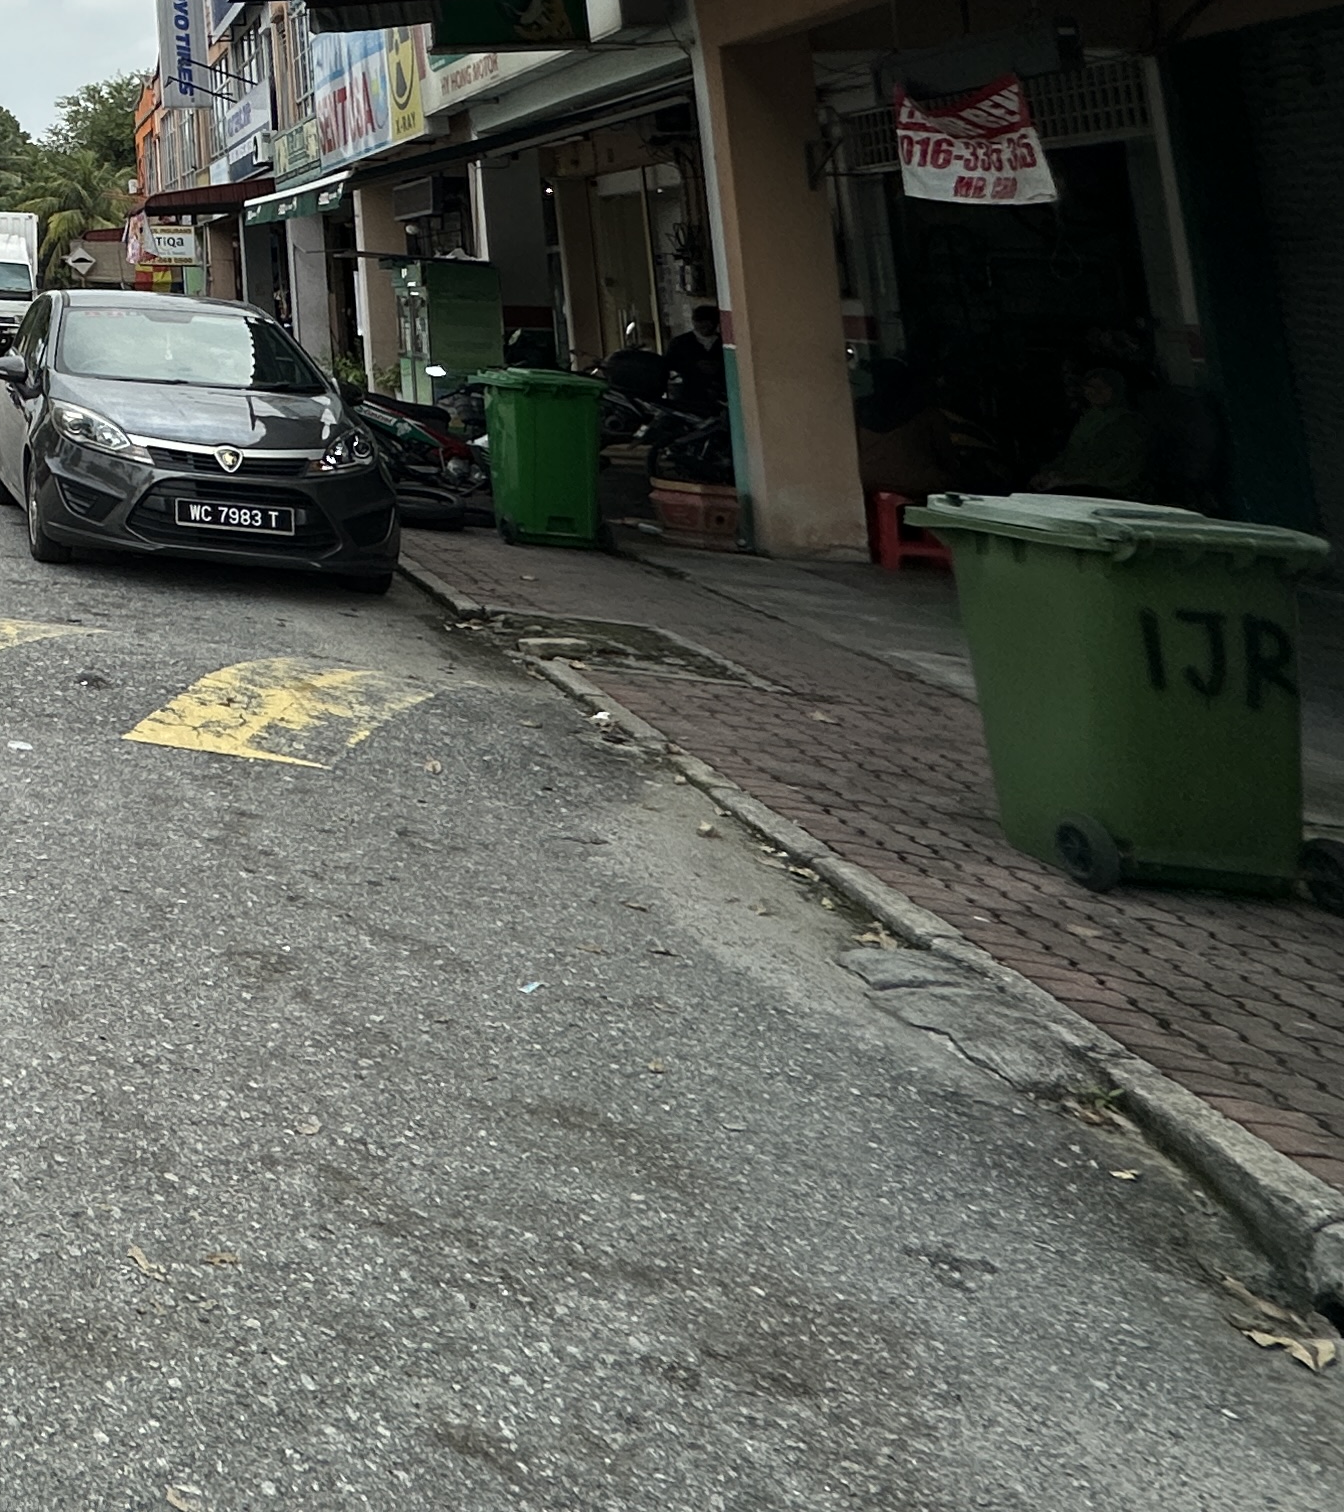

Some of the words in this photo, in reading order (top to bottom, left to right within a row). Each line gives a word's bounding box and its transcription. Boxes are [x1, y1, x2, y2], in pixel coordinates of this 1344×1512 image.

[176, 32, 195, 97] TIRES
[395, 112, 416, 134] X-RAY
[189, 504, 212, 522] WC
[218, 507, 262, 527] 7983
[268, 511, 279, 528] T
